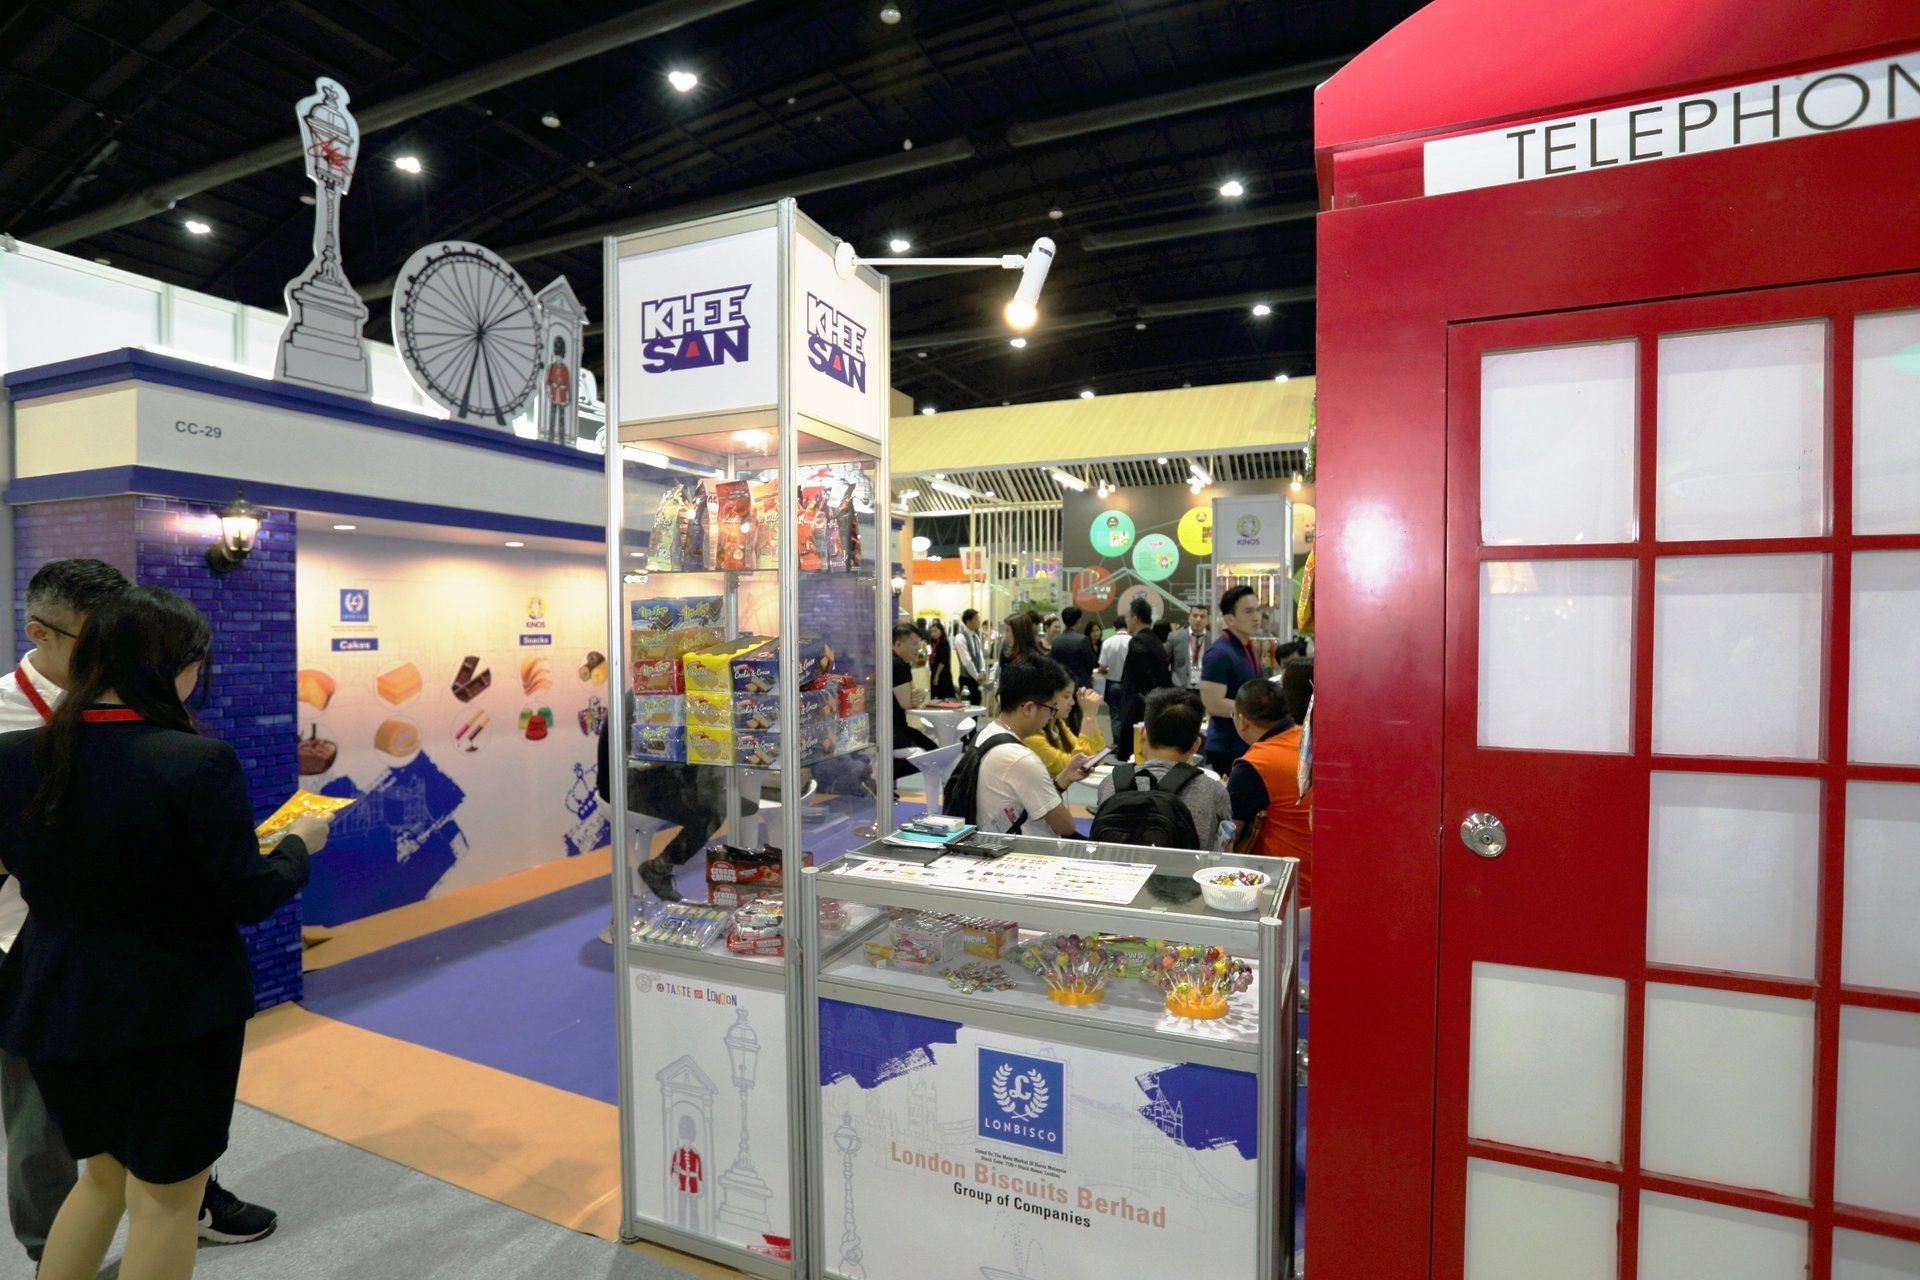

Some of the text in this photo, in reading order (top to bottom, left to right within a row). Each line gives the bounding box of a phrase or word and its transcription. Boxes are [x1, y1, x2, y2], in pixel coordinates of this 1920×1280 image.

[641, 284, 752, 343] KHEE
[807, 291, 867, 362] KHEE
[642, 328, 749, 373] SAN
[807, 334, 866, 393] SAN
[175, 420, 222, 438] CC-29
[1237, 538, 1260, 546] KINOS
[339, 640, 371, 649] Cakes
[666, 983, 692, 998] TASTE
[707, 988, 738, 1006] LONDON
[985, 1118, 1056, 1142] LONBISCO
[890, 1141, 1166, 1229] London Biscuits Berhad
[954, 1181, 1091, 1228] Group of Companies
